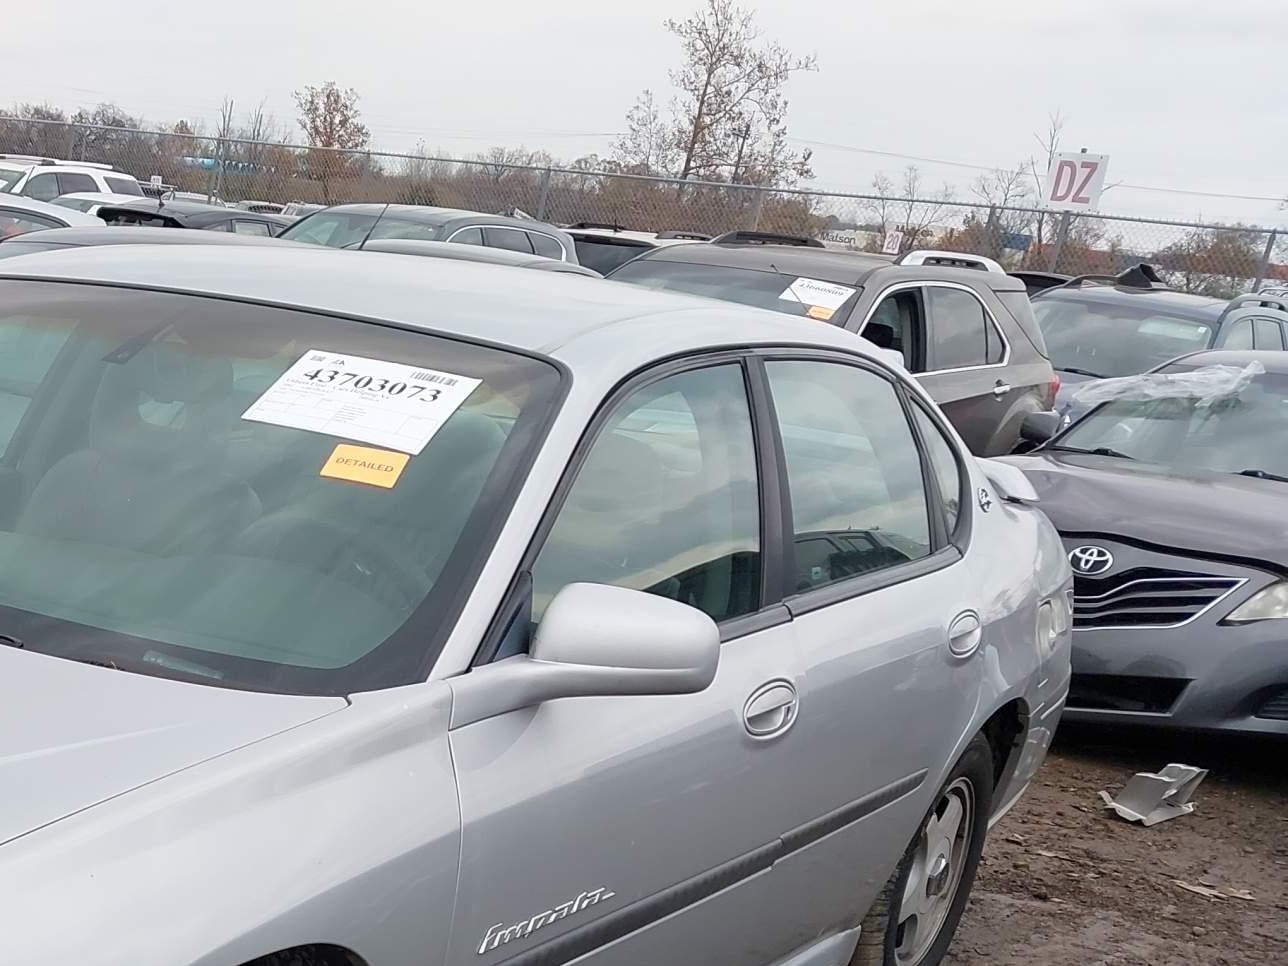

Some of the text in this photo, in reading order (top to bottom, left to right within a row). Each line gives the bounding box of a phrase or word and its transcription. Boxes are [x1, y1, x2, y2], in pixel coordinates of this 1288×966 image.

[1050, 159, 1099, 204] DZ
[304, 368, 442, 402] 43703073
[335, 456, 394, 473] DETAILED
[477, 887, 615, 954] Impala
